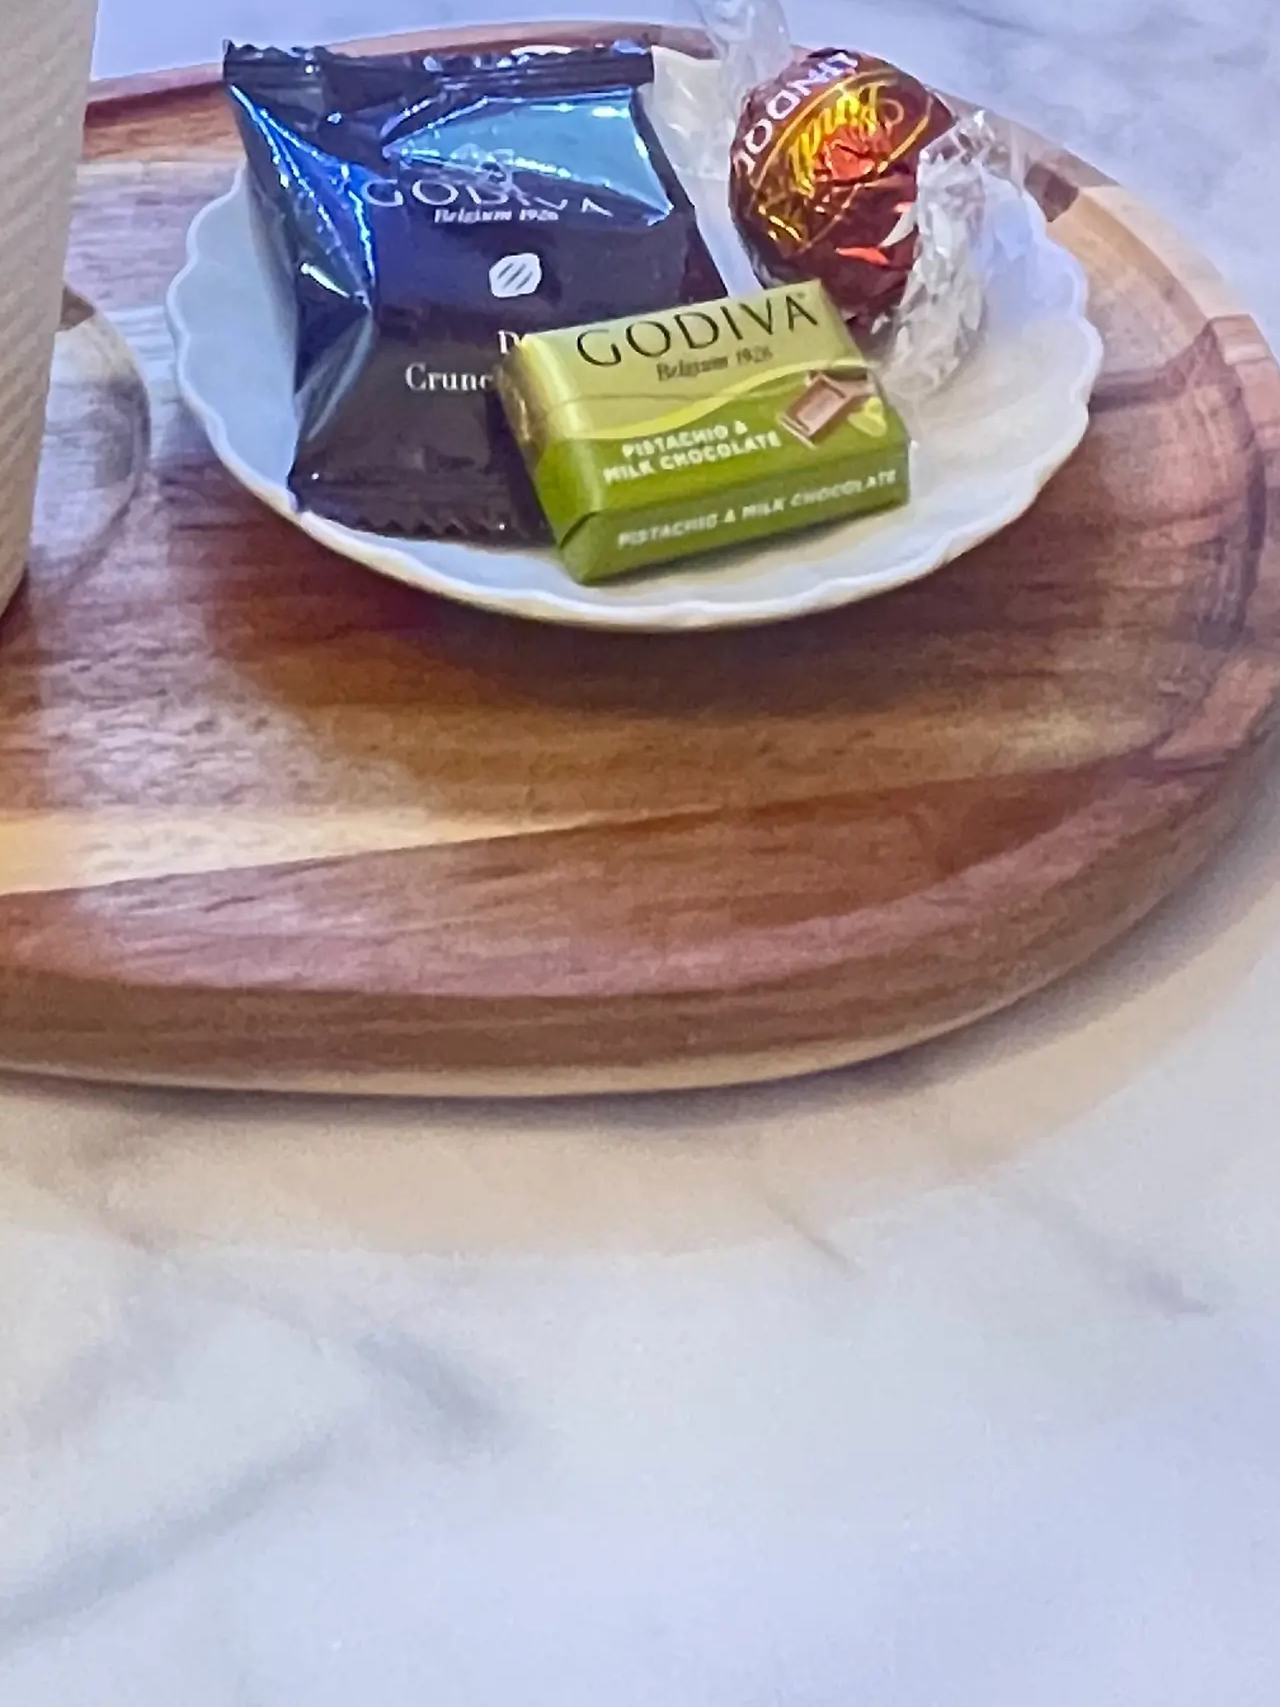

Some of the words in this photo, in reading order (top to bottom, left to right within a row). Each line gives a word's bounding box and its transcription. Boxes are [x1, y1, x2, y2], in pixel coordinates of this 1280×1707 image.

[362, 178, 614, 219] GODIVA
[577, 294, 819, 368] GODIVA
[602, 459, 657, 486] MILK
[659, 430, 782, 471] CHOCOLATE
[621, 424, 729, 459] PISTACHIO
[618, 513, 718, 549] PISTACHIO
[741, 497, 787, 521] MILK
[790, 469, 897, 508] CHOCOLATE
